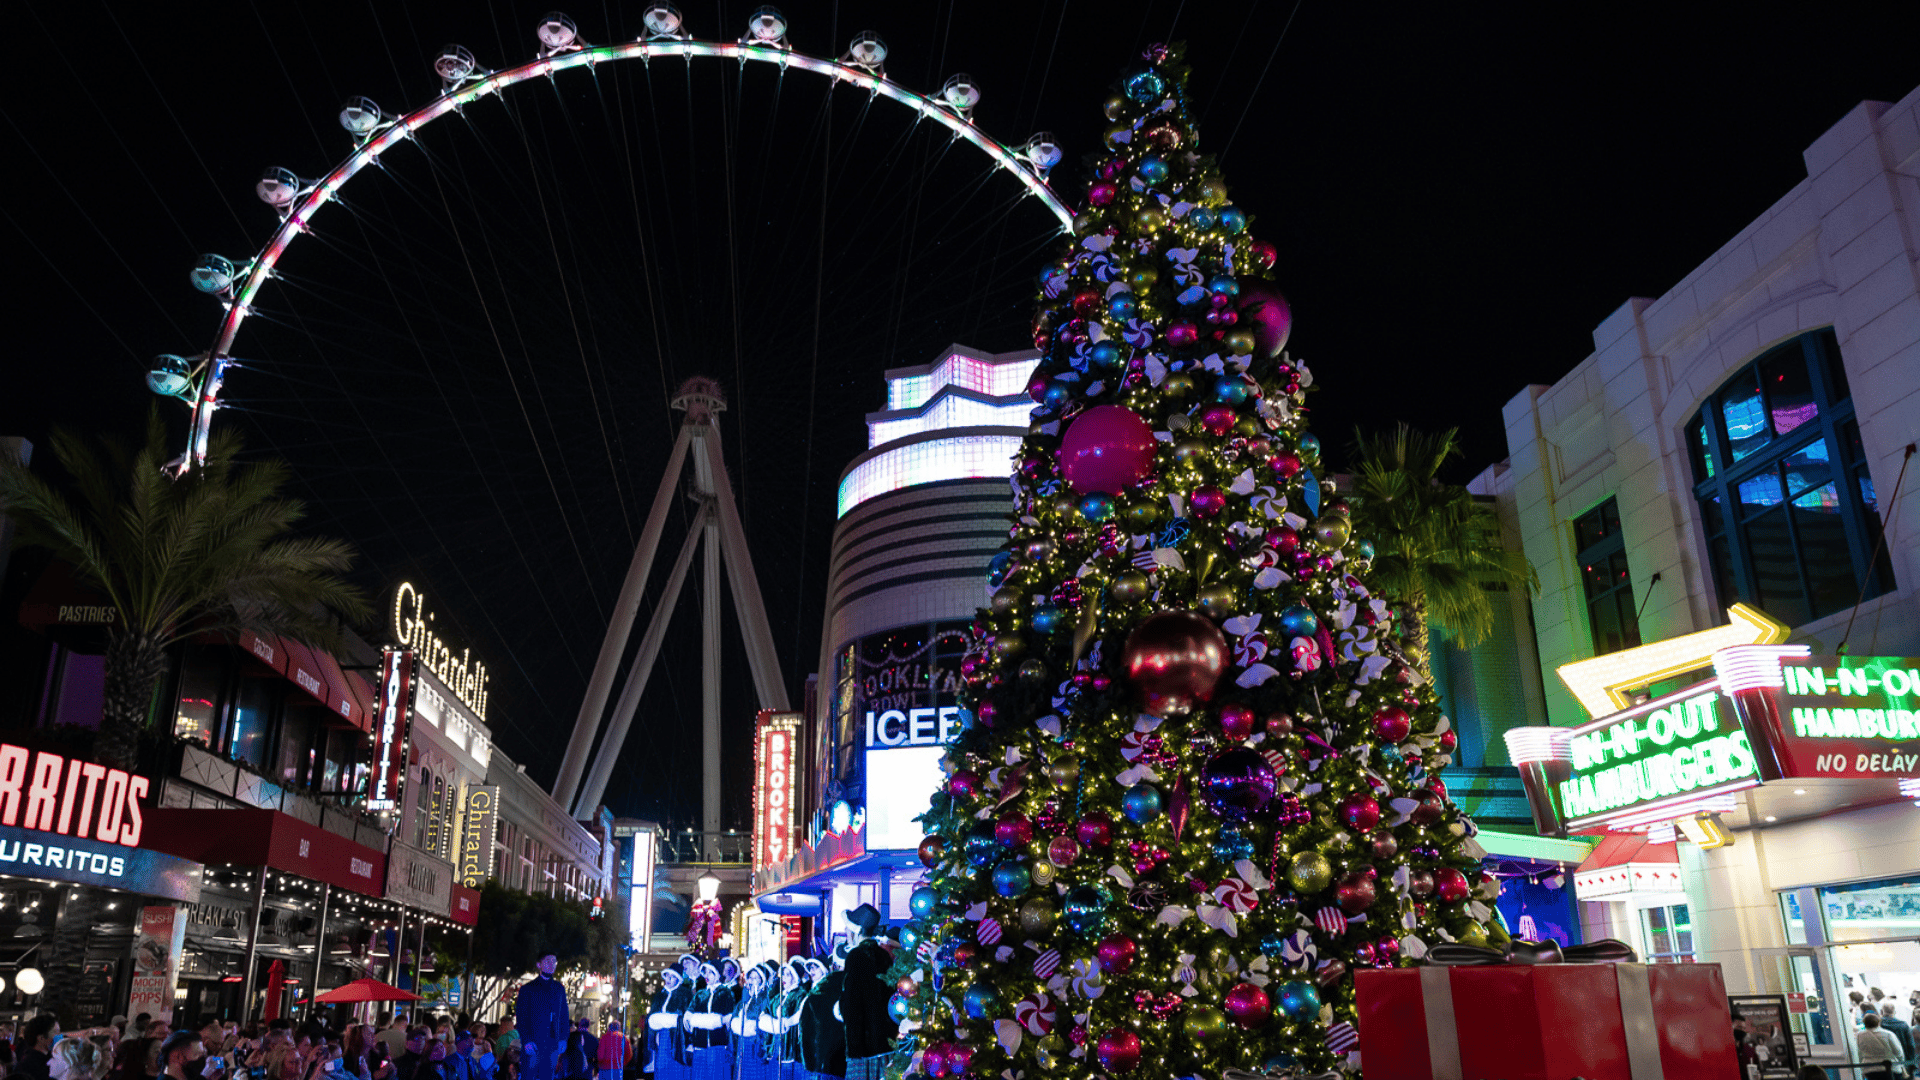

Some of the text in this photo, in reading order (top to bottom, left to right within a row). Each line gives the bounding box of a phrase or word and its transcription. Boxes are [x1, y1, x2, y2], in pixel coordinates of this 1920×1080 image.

[58, 605, 116, 623] PASTRIES
[396, 582, 489, 721] Ghirardelli
[376, 651, 402, 800] FAVORITE
[1570, 691, 1719, 771] IN-N-OUT
[1791, 707, 1920, 739] HAMBUR
[1559, 729, 1756, 819] HAMBURGERS
[1816, 753, 1919, 773] NO DELAY
[767, 733, 785, 864] BROOKLY
[299, 838, 310, 859] BAR
[463, 791, 491, 888] Ghirarde
[144, 913, 173, 924] SUSHI
[130, 992, 161, 1004] POPS
[133, 977, 163, 988] MOCHI
